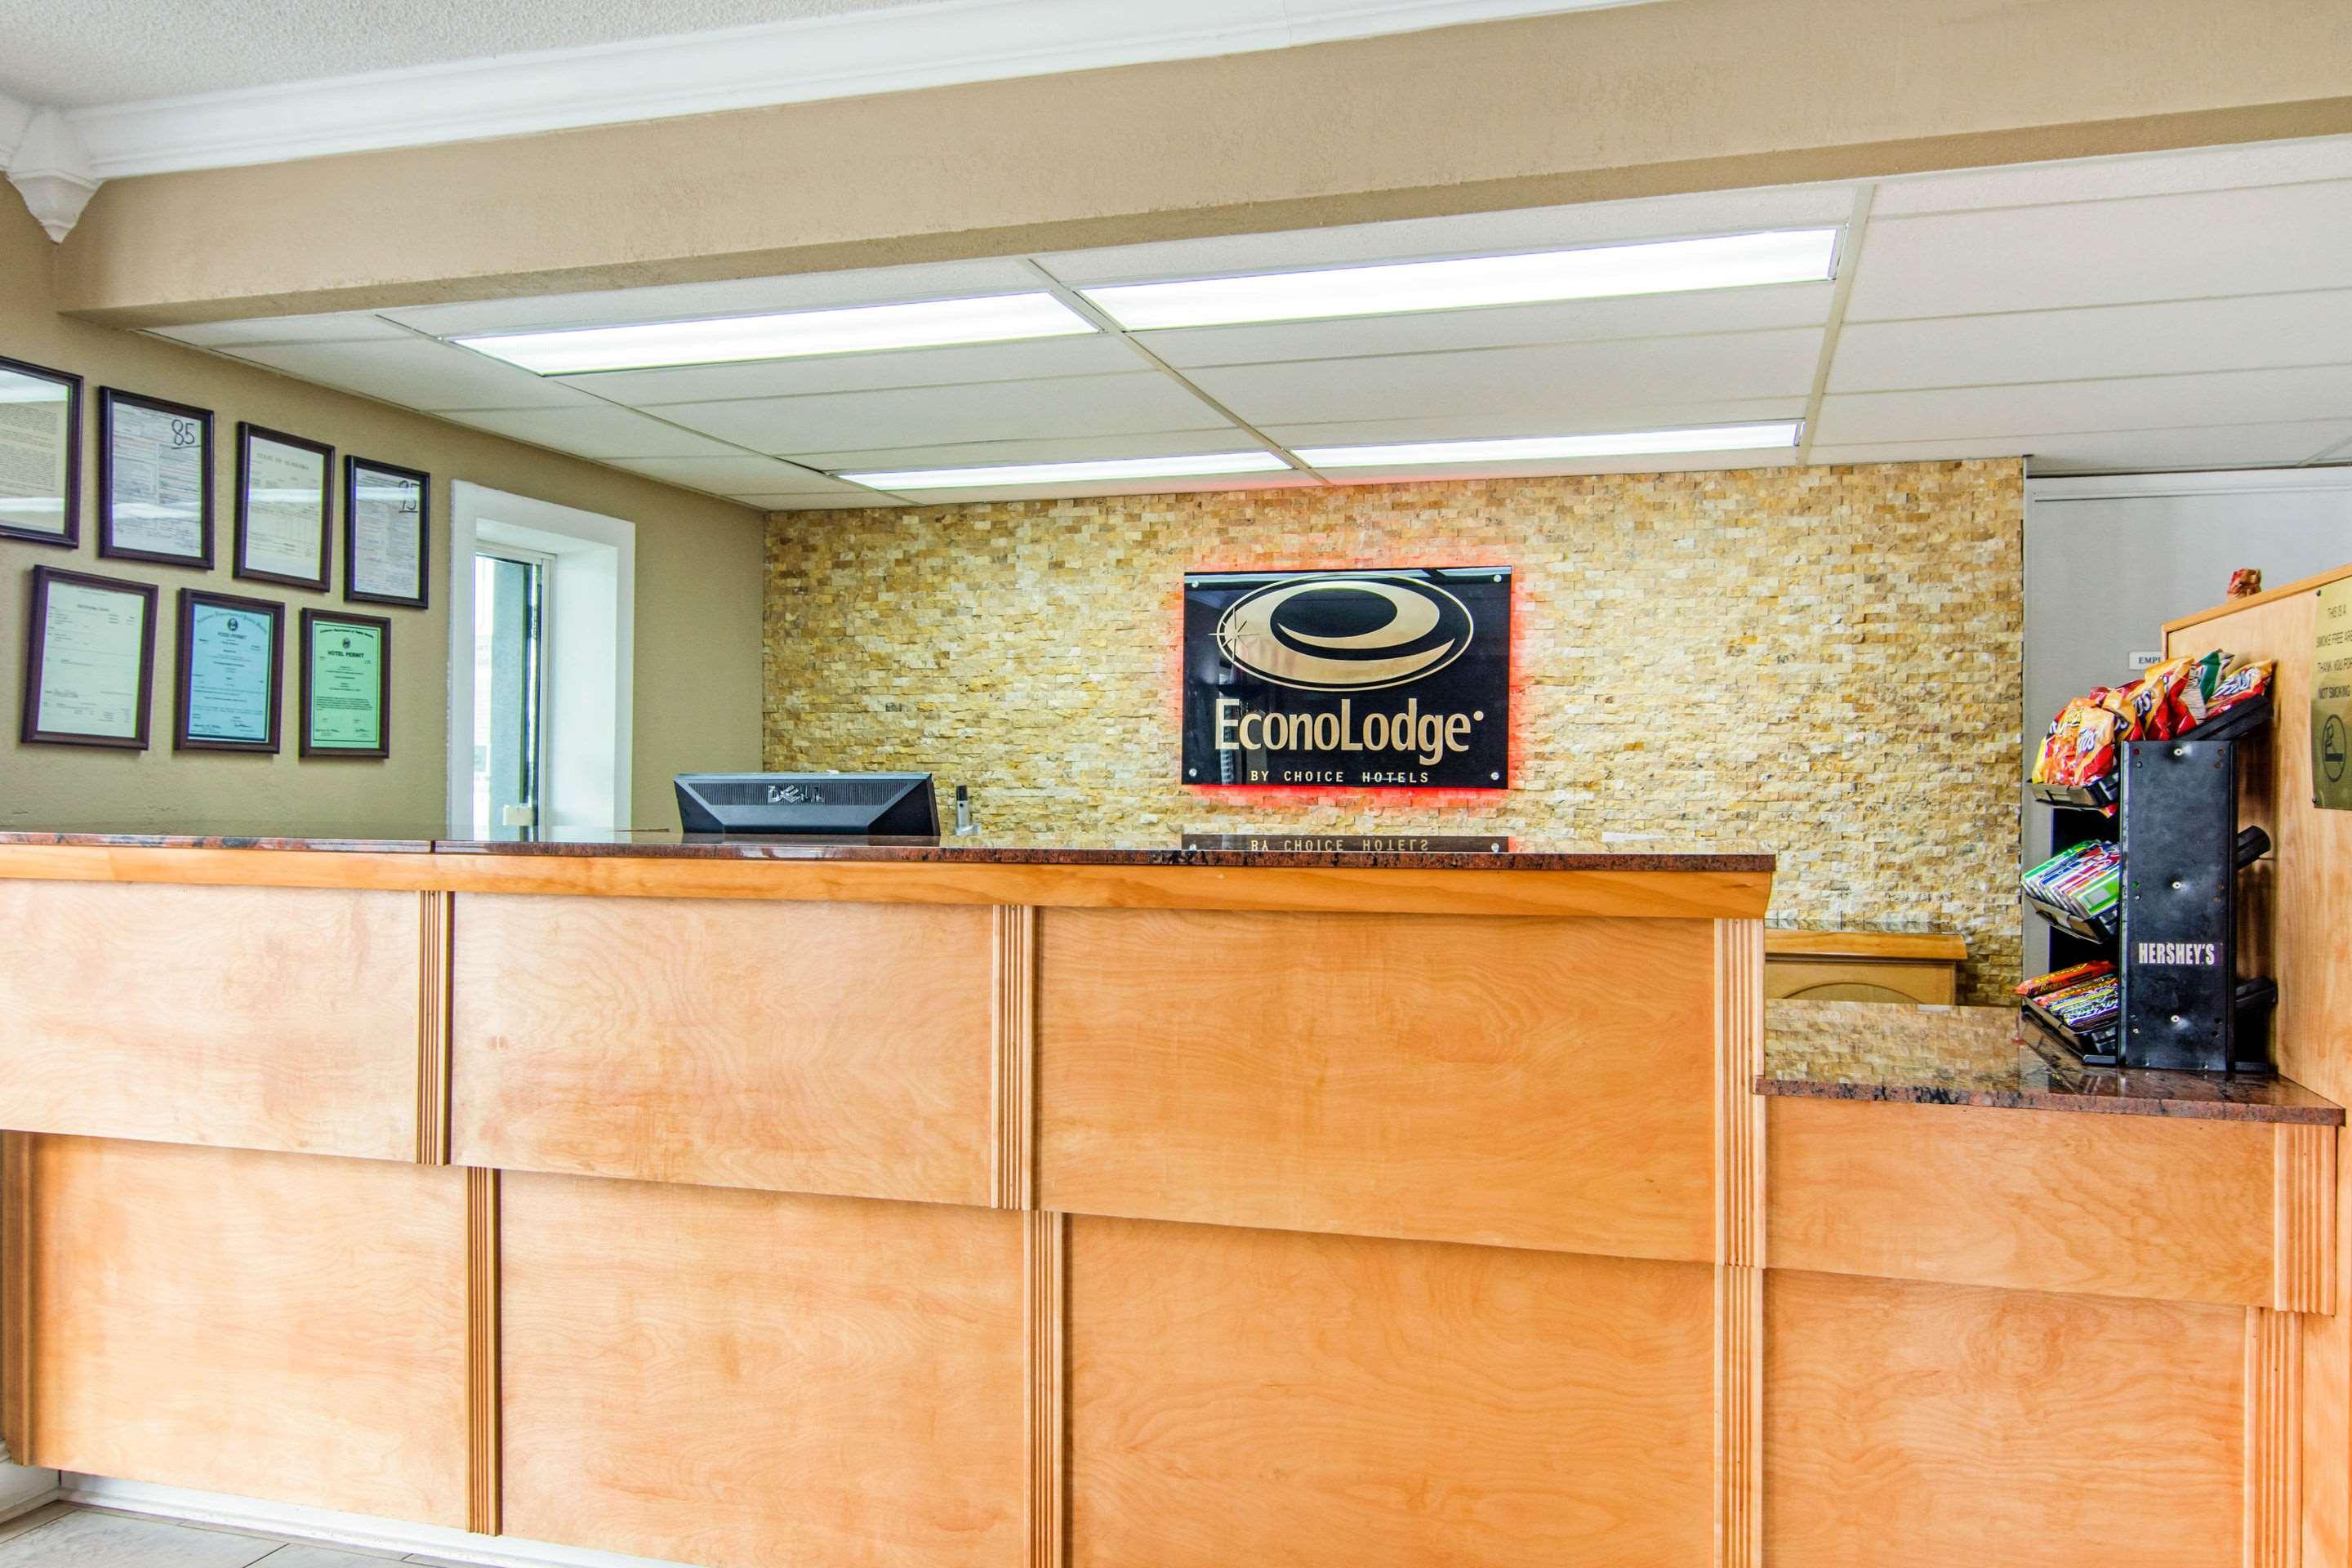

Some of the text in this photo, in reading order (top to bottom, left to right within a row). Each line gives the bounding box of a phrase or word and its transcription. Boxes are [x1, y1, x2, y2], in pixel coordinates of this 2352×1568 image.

[172, 419, 195, 446] 85
[1215, 697, 1471, 766] EconoLodge
[1251, 770, 1428, 783] BY CHOICE HOTELS
[2139, 942, 2215, 965] HERSHEY'S
